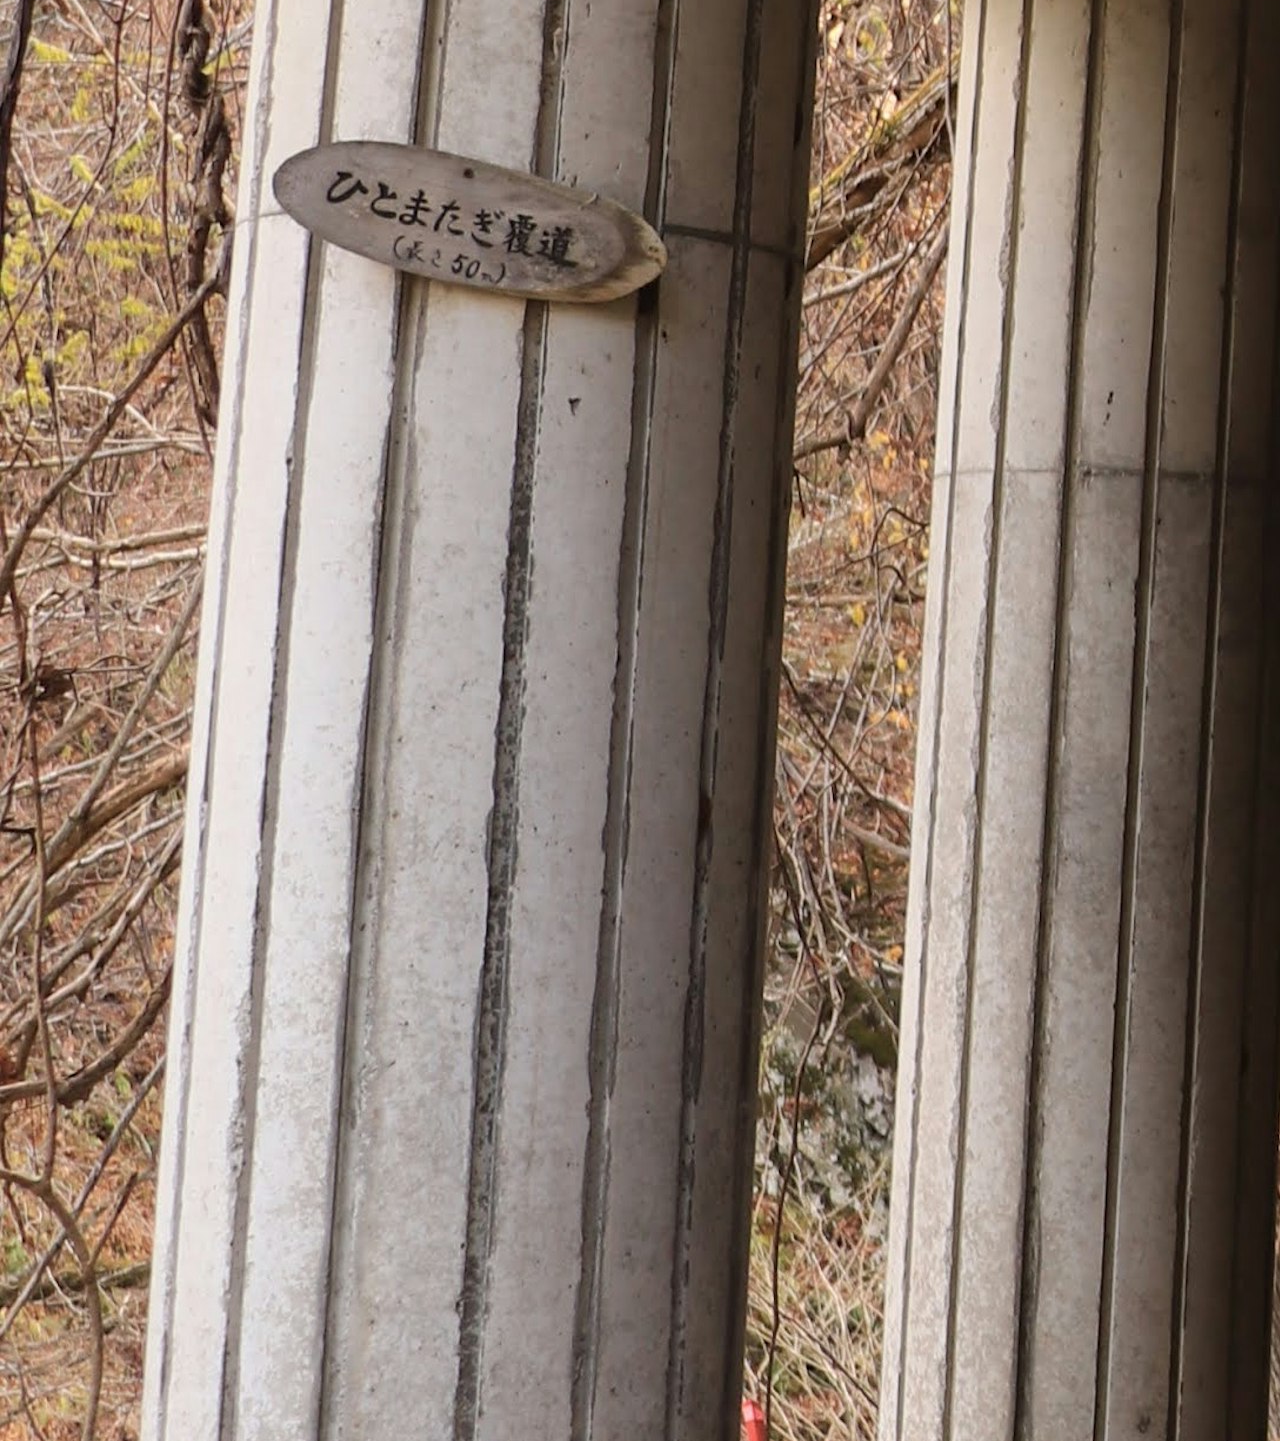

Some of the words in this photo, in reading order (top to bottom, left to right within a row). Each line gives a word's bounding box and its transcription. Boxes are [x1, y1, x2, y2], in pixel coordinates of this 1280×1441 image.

[326, 170, 579, 268] ひとまたぎ覆道
